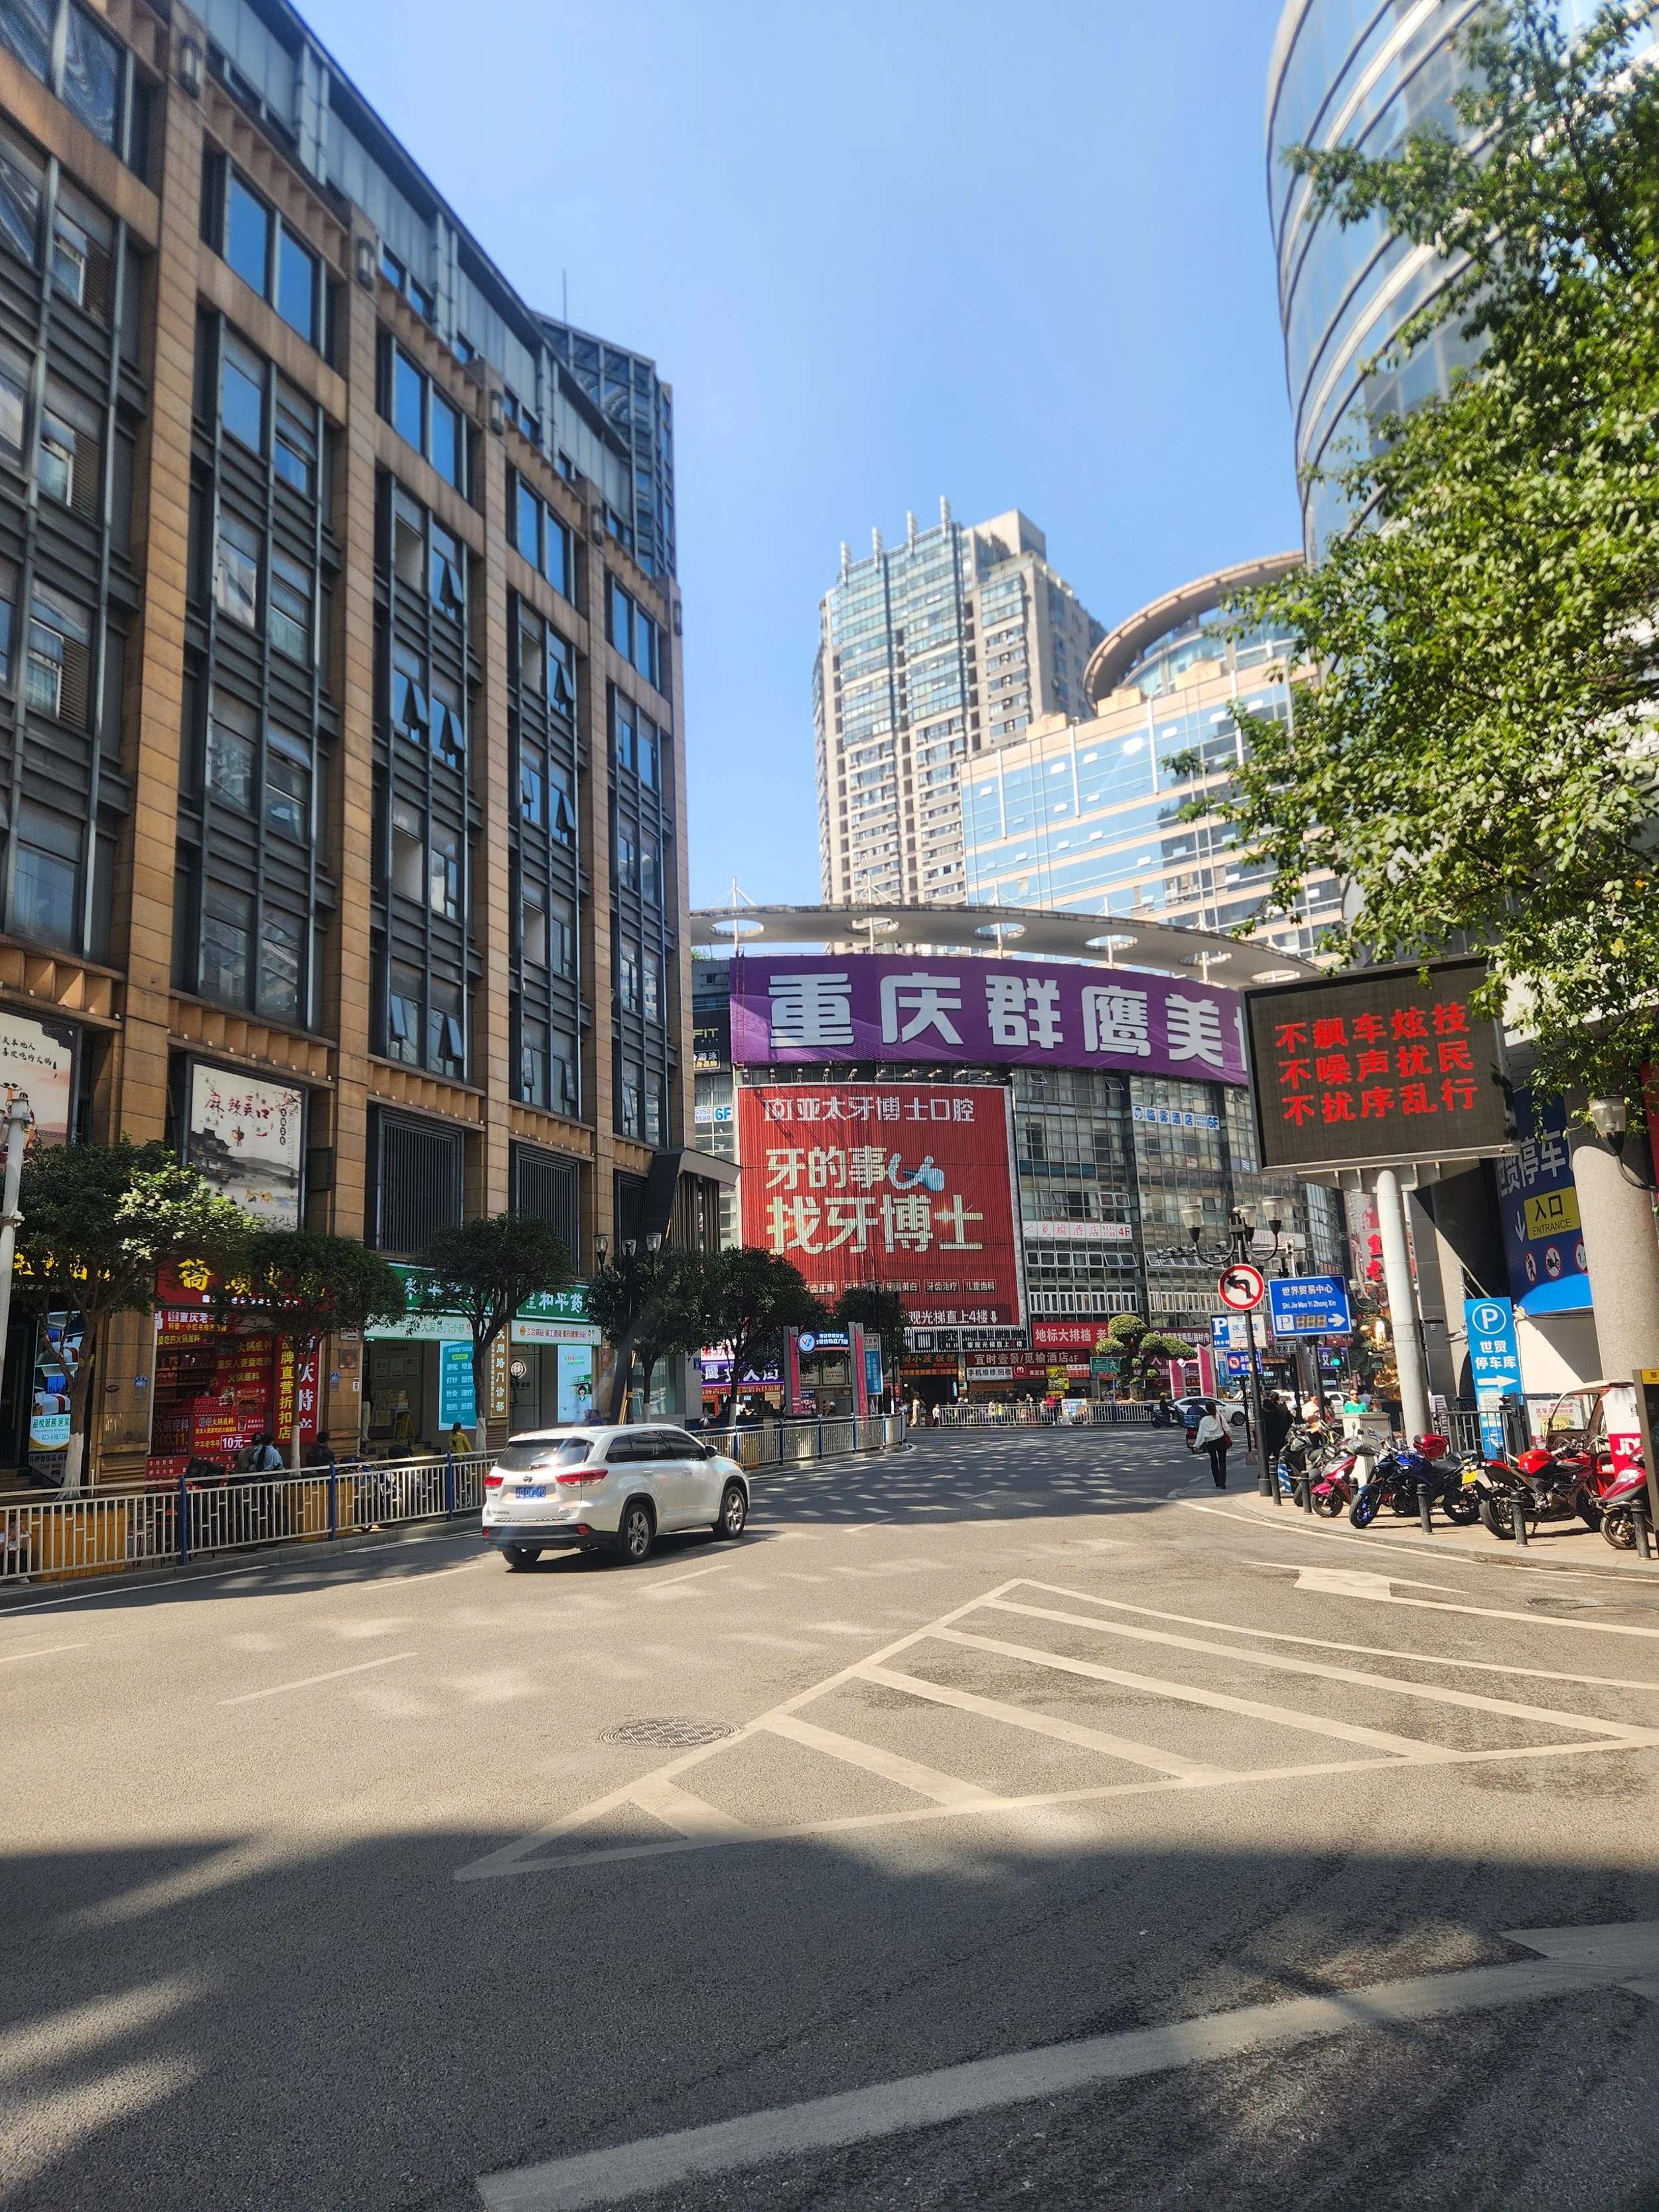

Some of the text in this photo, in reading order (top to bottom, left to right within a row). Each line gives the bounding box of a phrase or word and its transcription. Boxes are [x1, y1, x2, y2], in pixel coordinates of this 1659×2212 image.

[768, 972, 1246, 1070] 重庆群鹰美
[1277, 1040, 1475, 1090] 不噪声扰民
[796, 1096, 975, 1123] 亚太牙博士口腔
[1281, 1078, 1479, 1127] 不扰序乱行
[715, 1107, 731, 1120] 6F
[1207, 1116, 1218, 1128] 6F
[766, 1145, 889, 1190] 牙的事
[1535, 1195, 1564, 1222] 入口
[766, 1194, 983, 1256] 找牙博士
[1041, 1223, 1099, 1237] 觅榆酒店
[1532, 1218, 1572, 1236] ENTRANCE
[926, 1280, 958, 1291] 牙齿治疗
[1281, 1284, 1333, 1296] 世界贸易中心
[539, 1292, 596, 1314] 和平药
[902, 1309, 988, 1325] 观光梯直上4楼
[1212, 1317, 1227, 1335] P
[1279, 1316, 1291, 1329] P
[1480, 1308, 1498, 1330] P
[1035, 1329, 1091, 1343] 地标大排档
[1480, 1340, 1507, 1354] 世贸
[1475, 1355, 1516, 1370] 停车库
